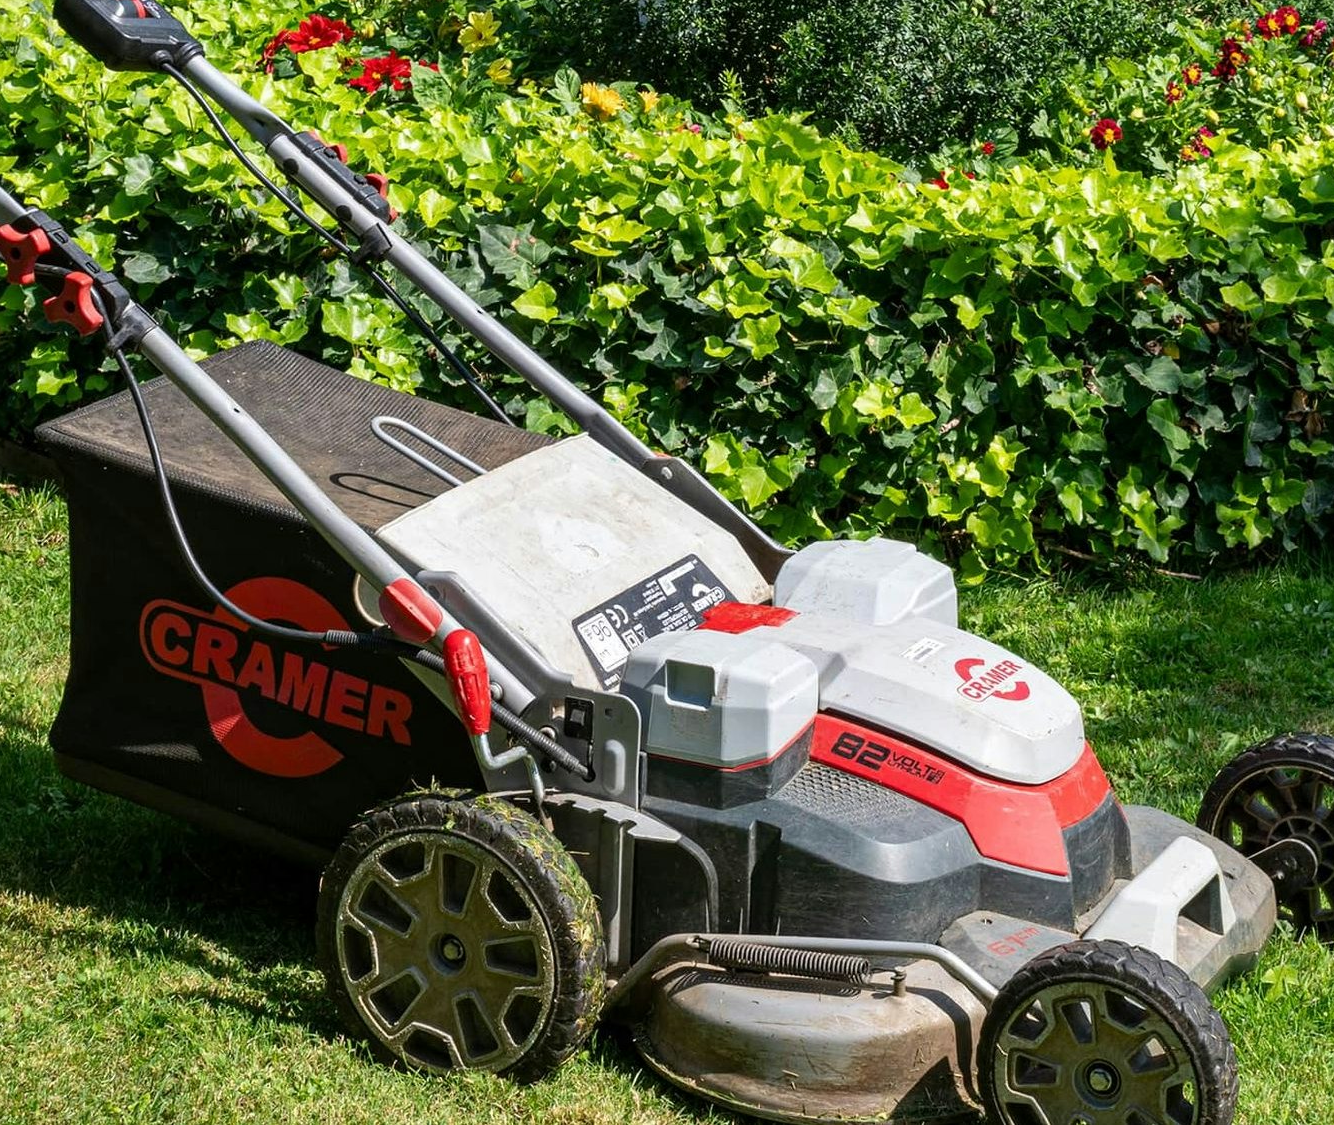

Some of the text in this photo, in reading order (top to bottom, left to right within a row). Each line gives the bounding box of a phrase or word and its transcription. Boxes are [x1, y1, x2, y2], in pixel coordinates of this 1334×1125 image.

[691, 589, 723, 612] CRAMER
[591, 620, 612, 641] 96
[150, 612, 413, 746] CRAMER
[962, 660, 1023, 699] CRAMER
[831, 732, 937, 776] 82 VOLT
